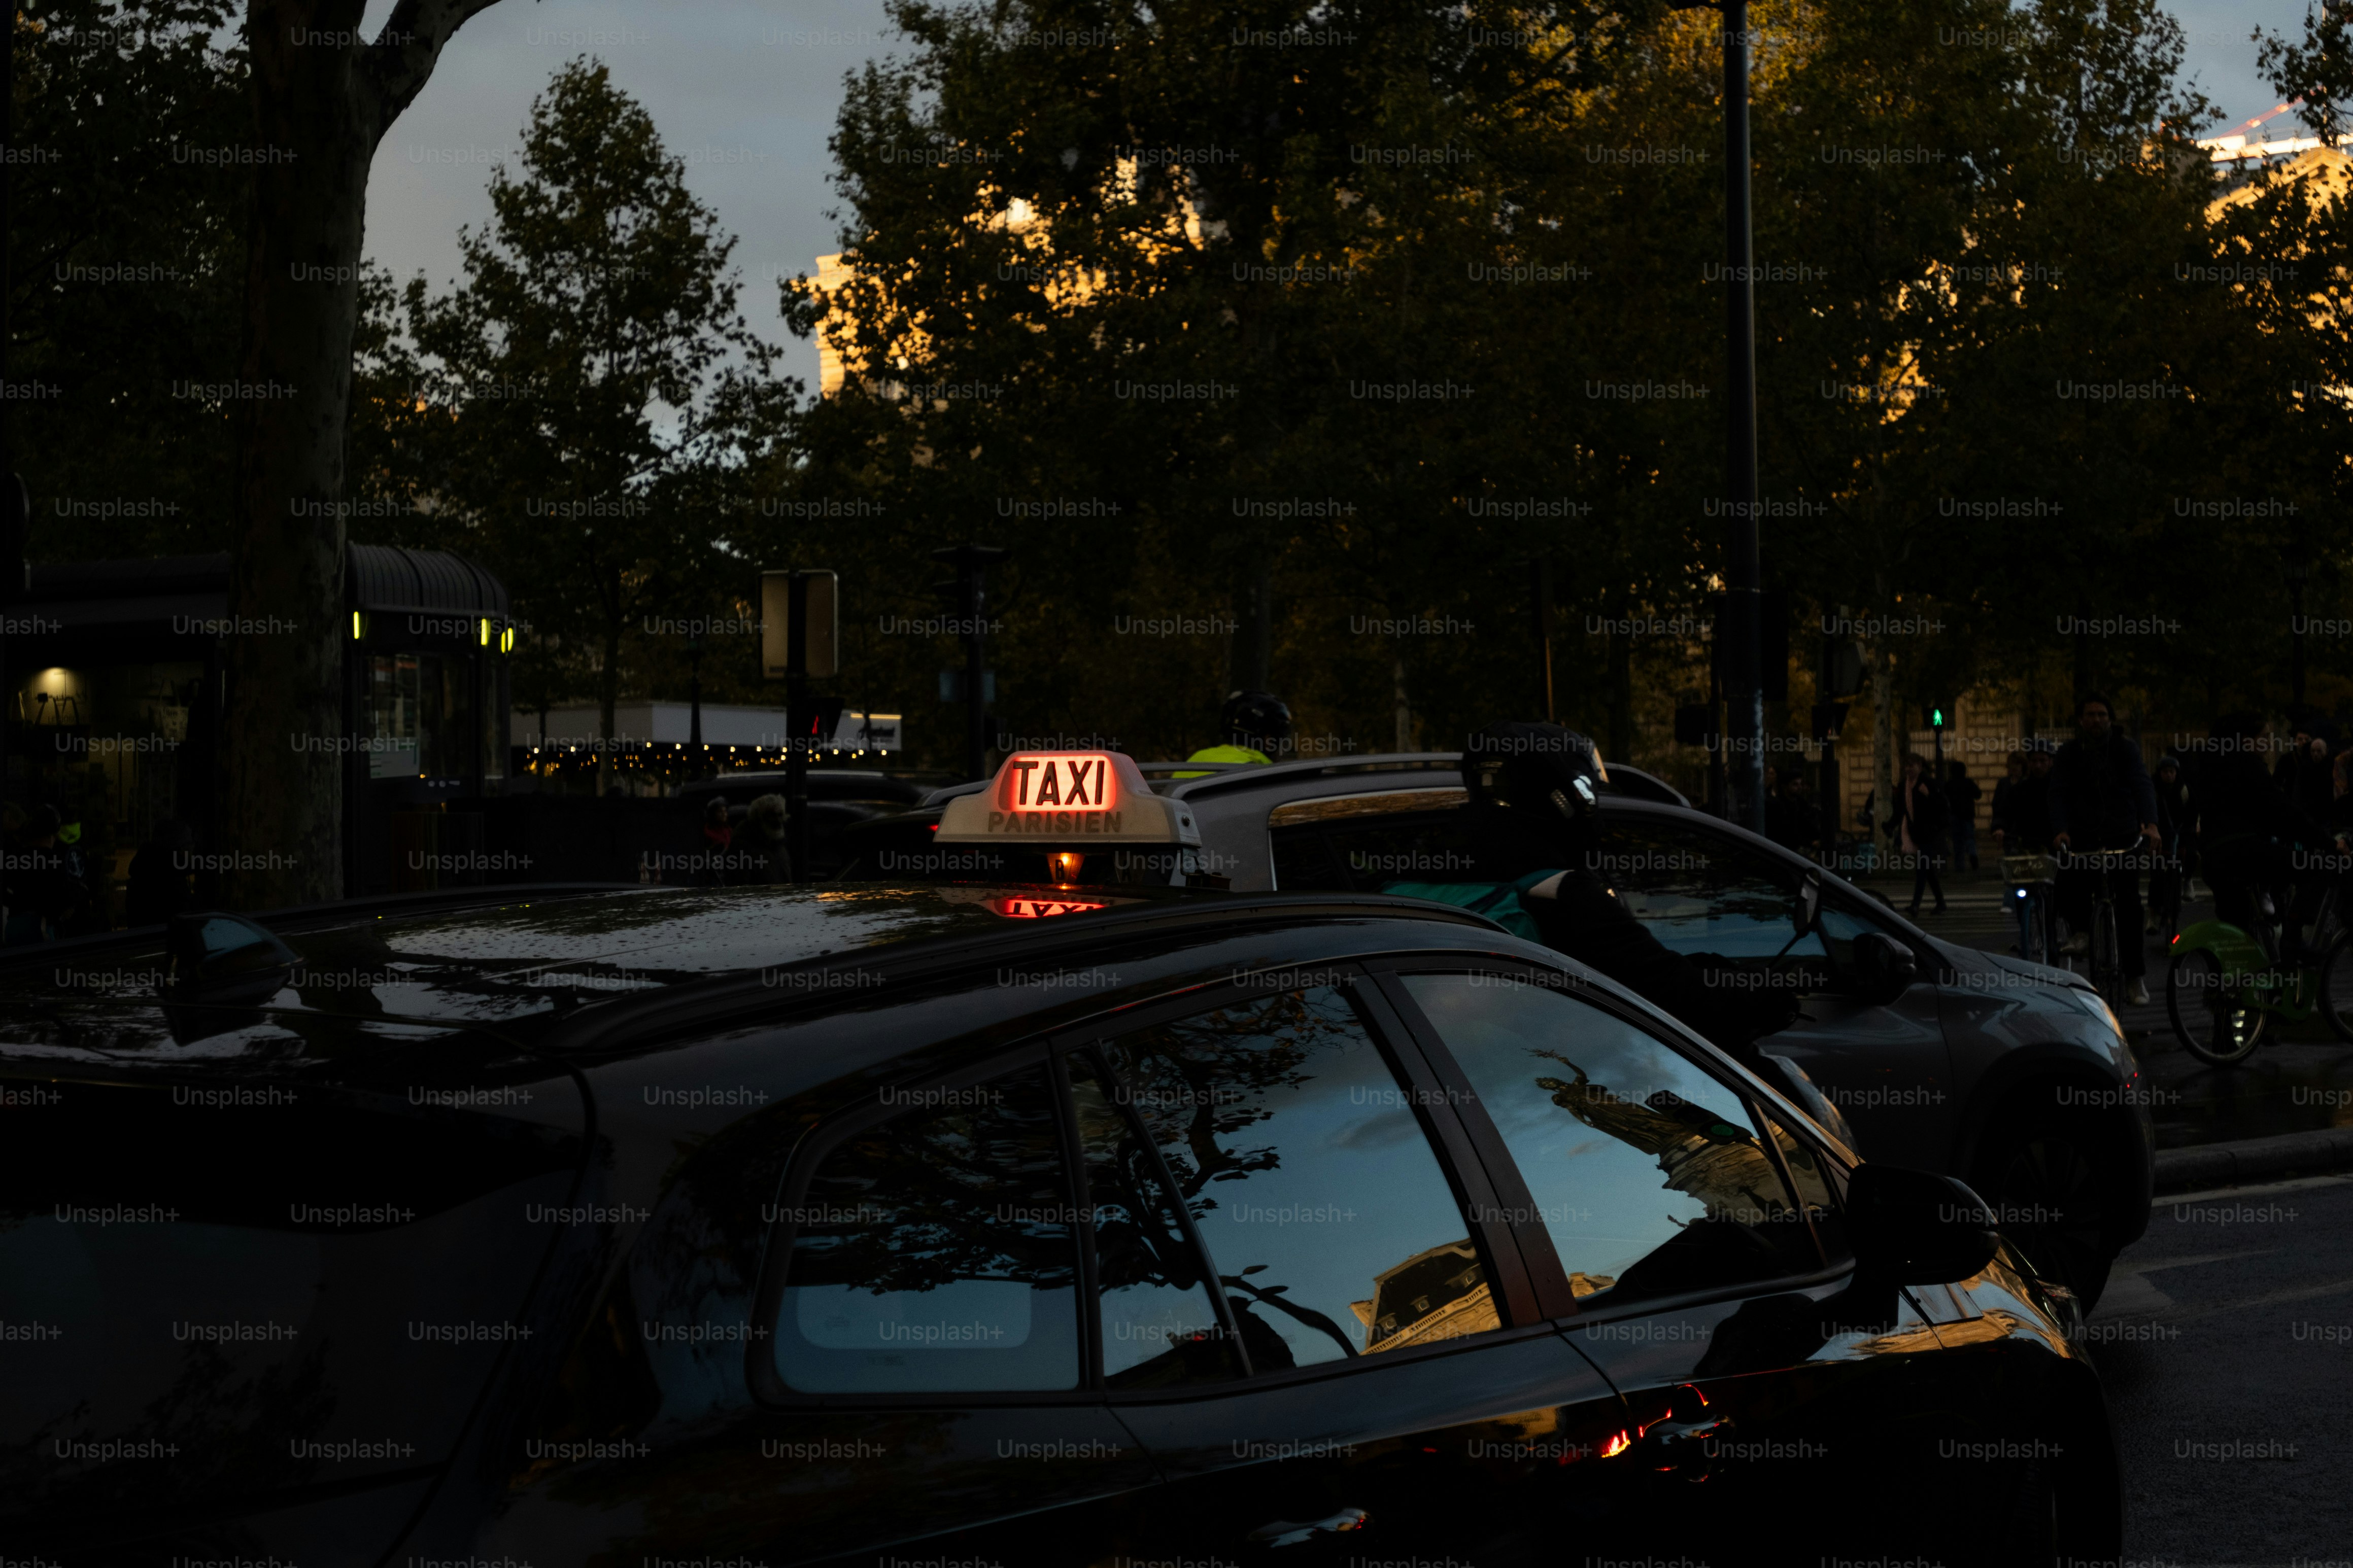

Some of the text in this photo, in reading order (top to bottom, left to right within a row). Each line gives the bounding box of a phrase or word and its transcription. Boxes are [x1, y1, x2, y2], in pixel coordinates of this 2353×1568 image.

[1013, 760, 1105, 806] TAXI
[988, 812, 1121, 832] PARISIEN
[1055, 859, 1065, 880] B
